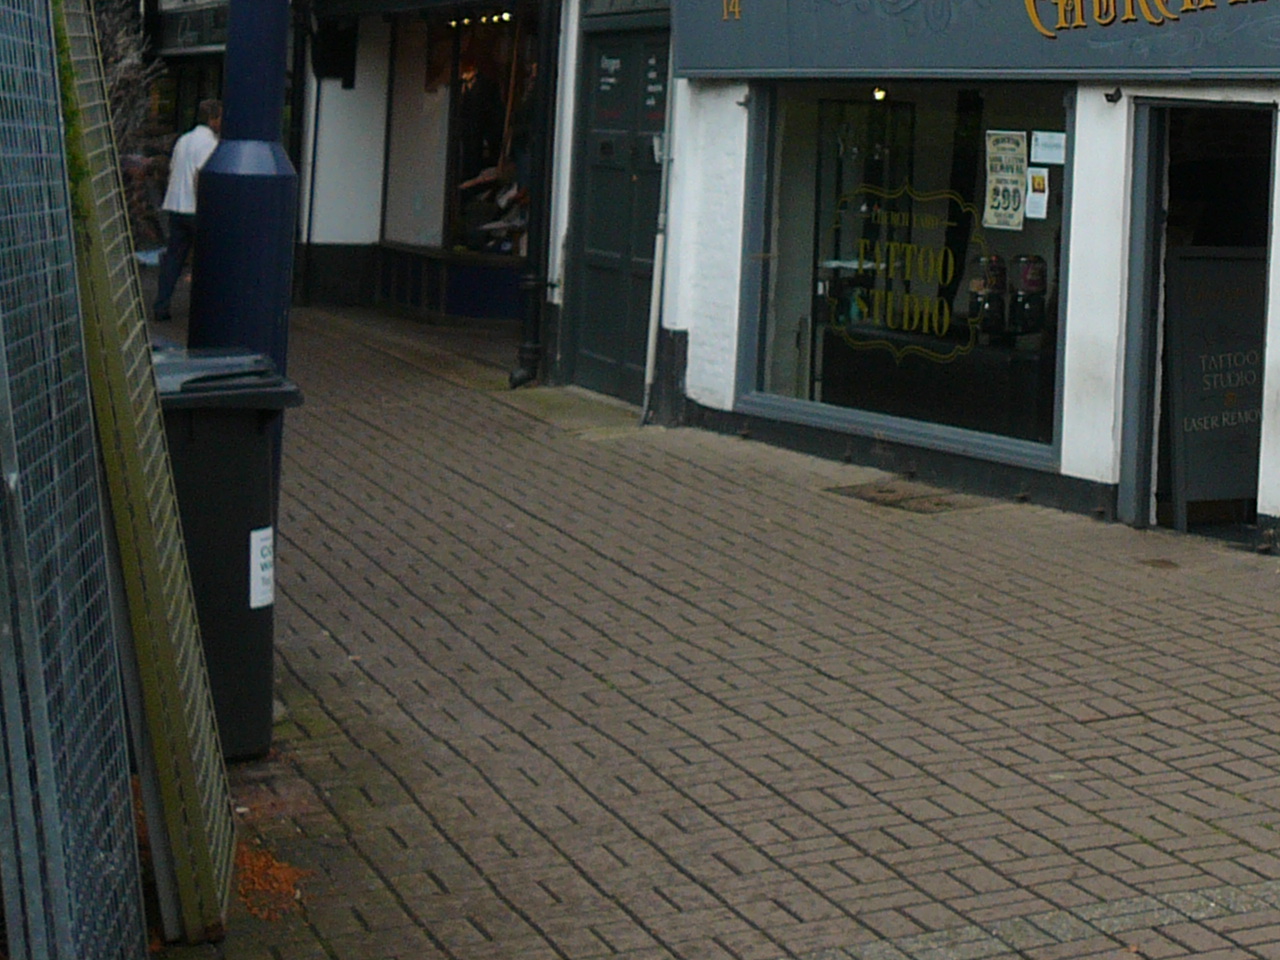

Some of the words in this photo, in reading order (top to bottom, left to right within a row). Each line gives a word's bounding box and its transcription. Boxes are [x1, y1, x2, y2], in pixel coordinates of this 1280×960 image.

[854, 238, 955, 286] TATTOO
[1199, 349, 1258, 372] TATTOO
[1202, 370, 1257, 391] STUDIO
